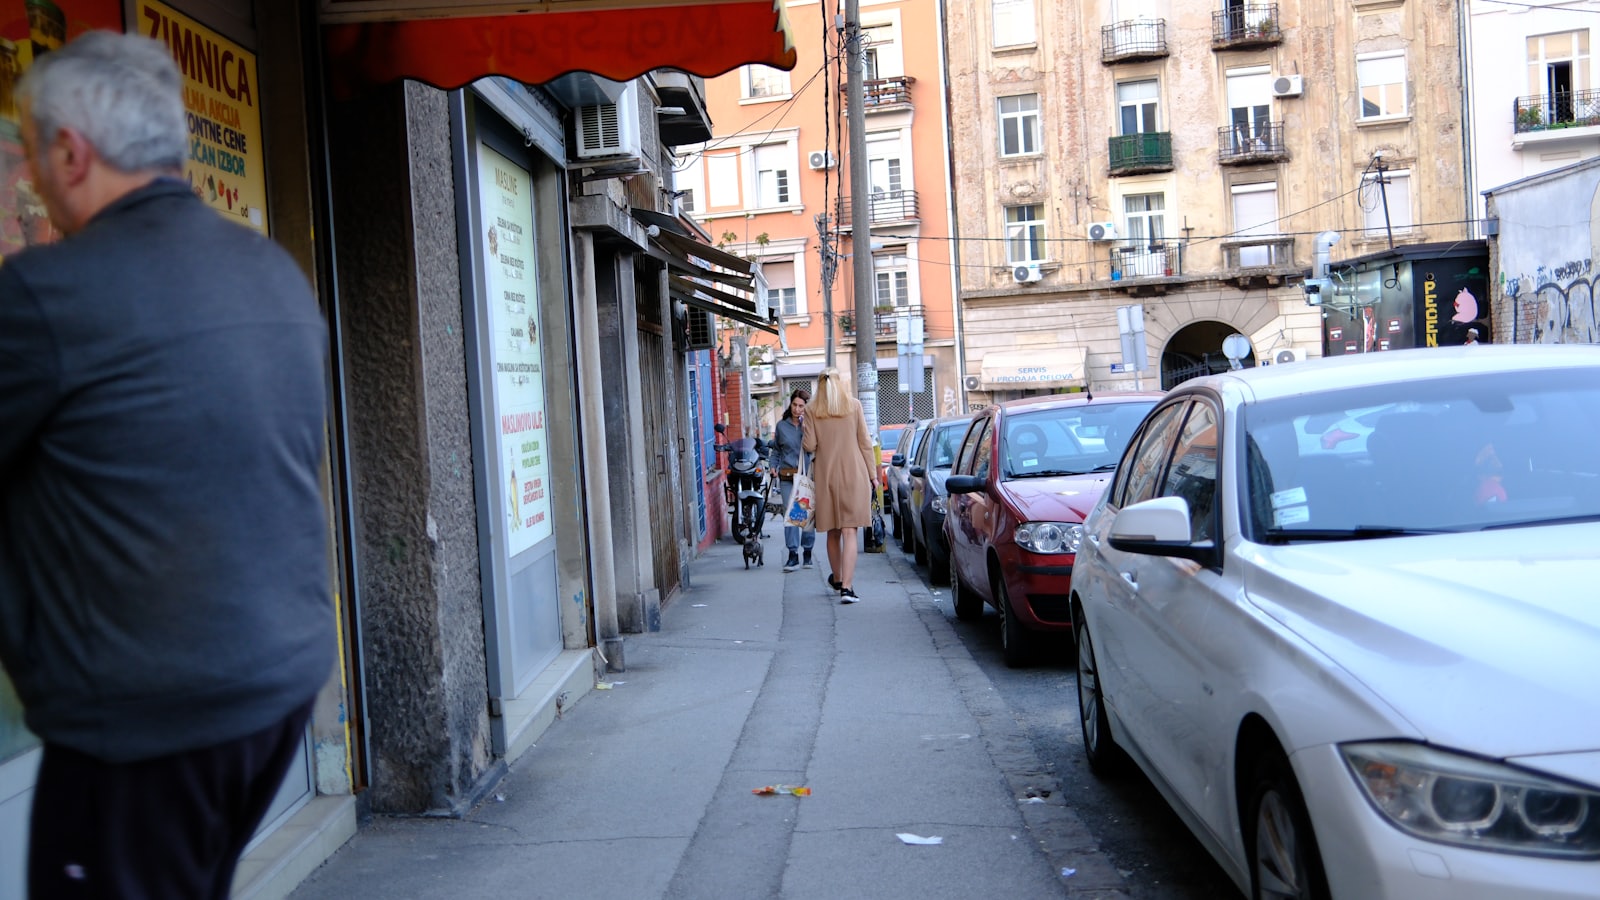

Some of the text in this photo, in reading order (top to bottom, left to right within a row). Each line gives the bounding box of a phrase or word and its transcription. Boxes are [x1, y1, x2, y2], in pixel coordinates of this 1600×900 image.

[223, 127, 247, 154] CENE
[217, 149, 246, 178] IZBOR
[997, 375, 1037, 383] PRODAJA
[1040, 373, 1073, 381] DELOVA
[1018, 366, 1047, 374] SERVIS
